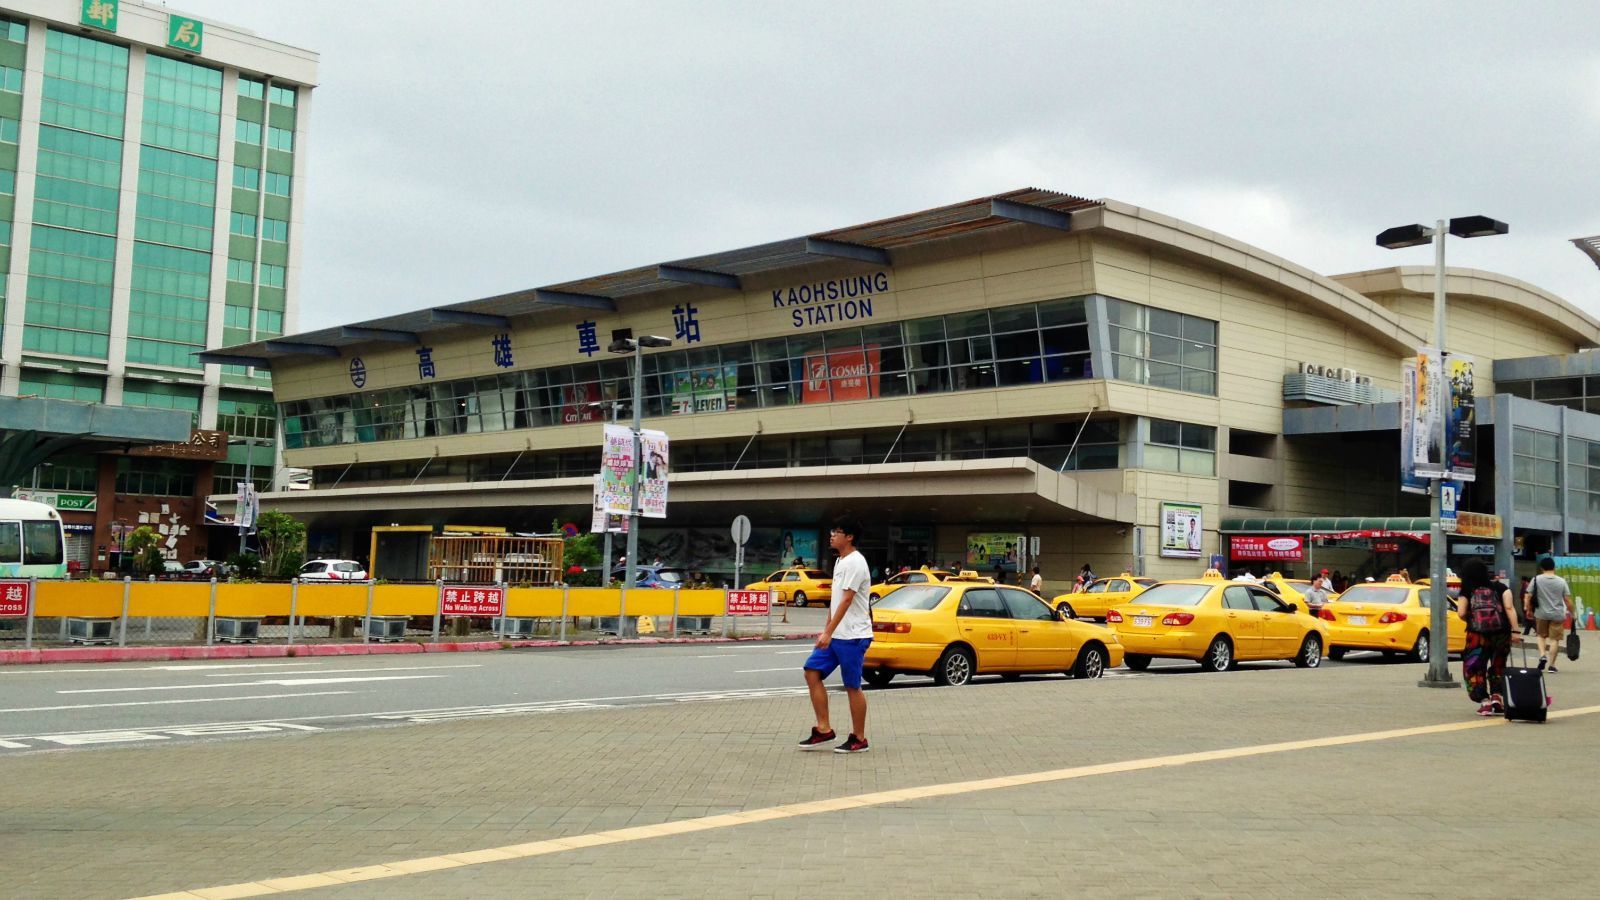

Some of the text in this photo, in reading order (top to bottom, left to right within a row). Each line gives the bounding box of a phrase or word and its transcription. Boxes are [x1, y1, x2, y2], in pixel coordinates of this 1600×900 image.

[772, 272, 888, 308] KAOHSIUNG
[792, 298, 873, 328] STATION
[416, 302, 700, 380] 高雄車站
[60, 499, 83, 507] POST
[446, 591, 498, 603] 禁止跨越
[730, 592, 767, 604] 禁止跨越
[454, 604, 477, 612] Walking
